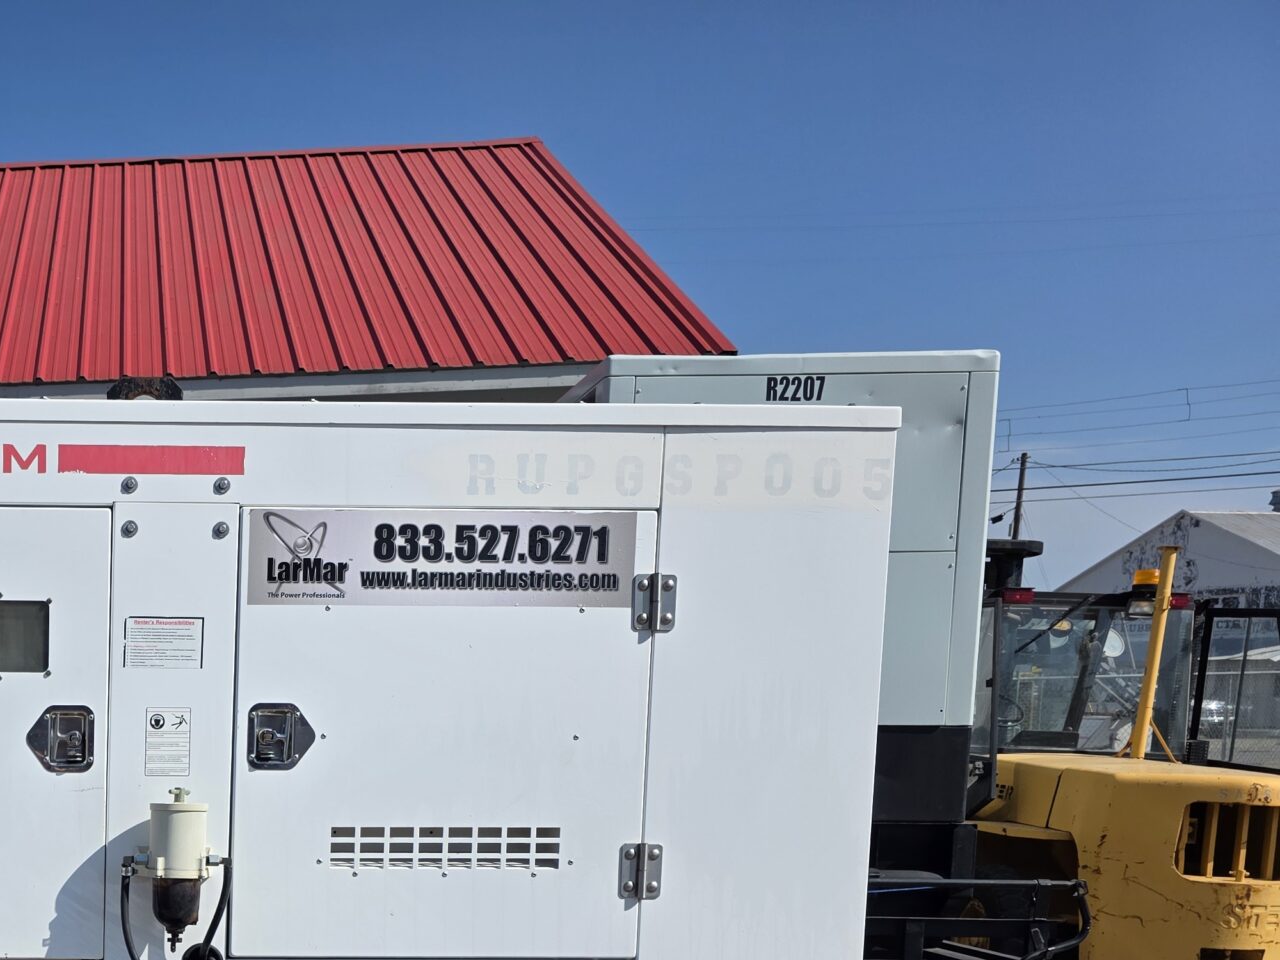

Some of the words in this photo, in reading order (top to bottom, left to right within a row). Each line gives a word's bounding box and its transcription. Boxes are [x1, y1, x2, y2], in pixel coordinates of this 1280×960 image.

[765, 375, 826, 401] R2207
[373, 523, 611, 564] 833.527.6271
[266, 557, 349, 584] LarMar
[359, 568, 620, 592] www.larmarindustries.com
[267, 591, 280, 599] The
[280, 591, 301, 599] Power
[302, 591, 346, 600] Professionals
